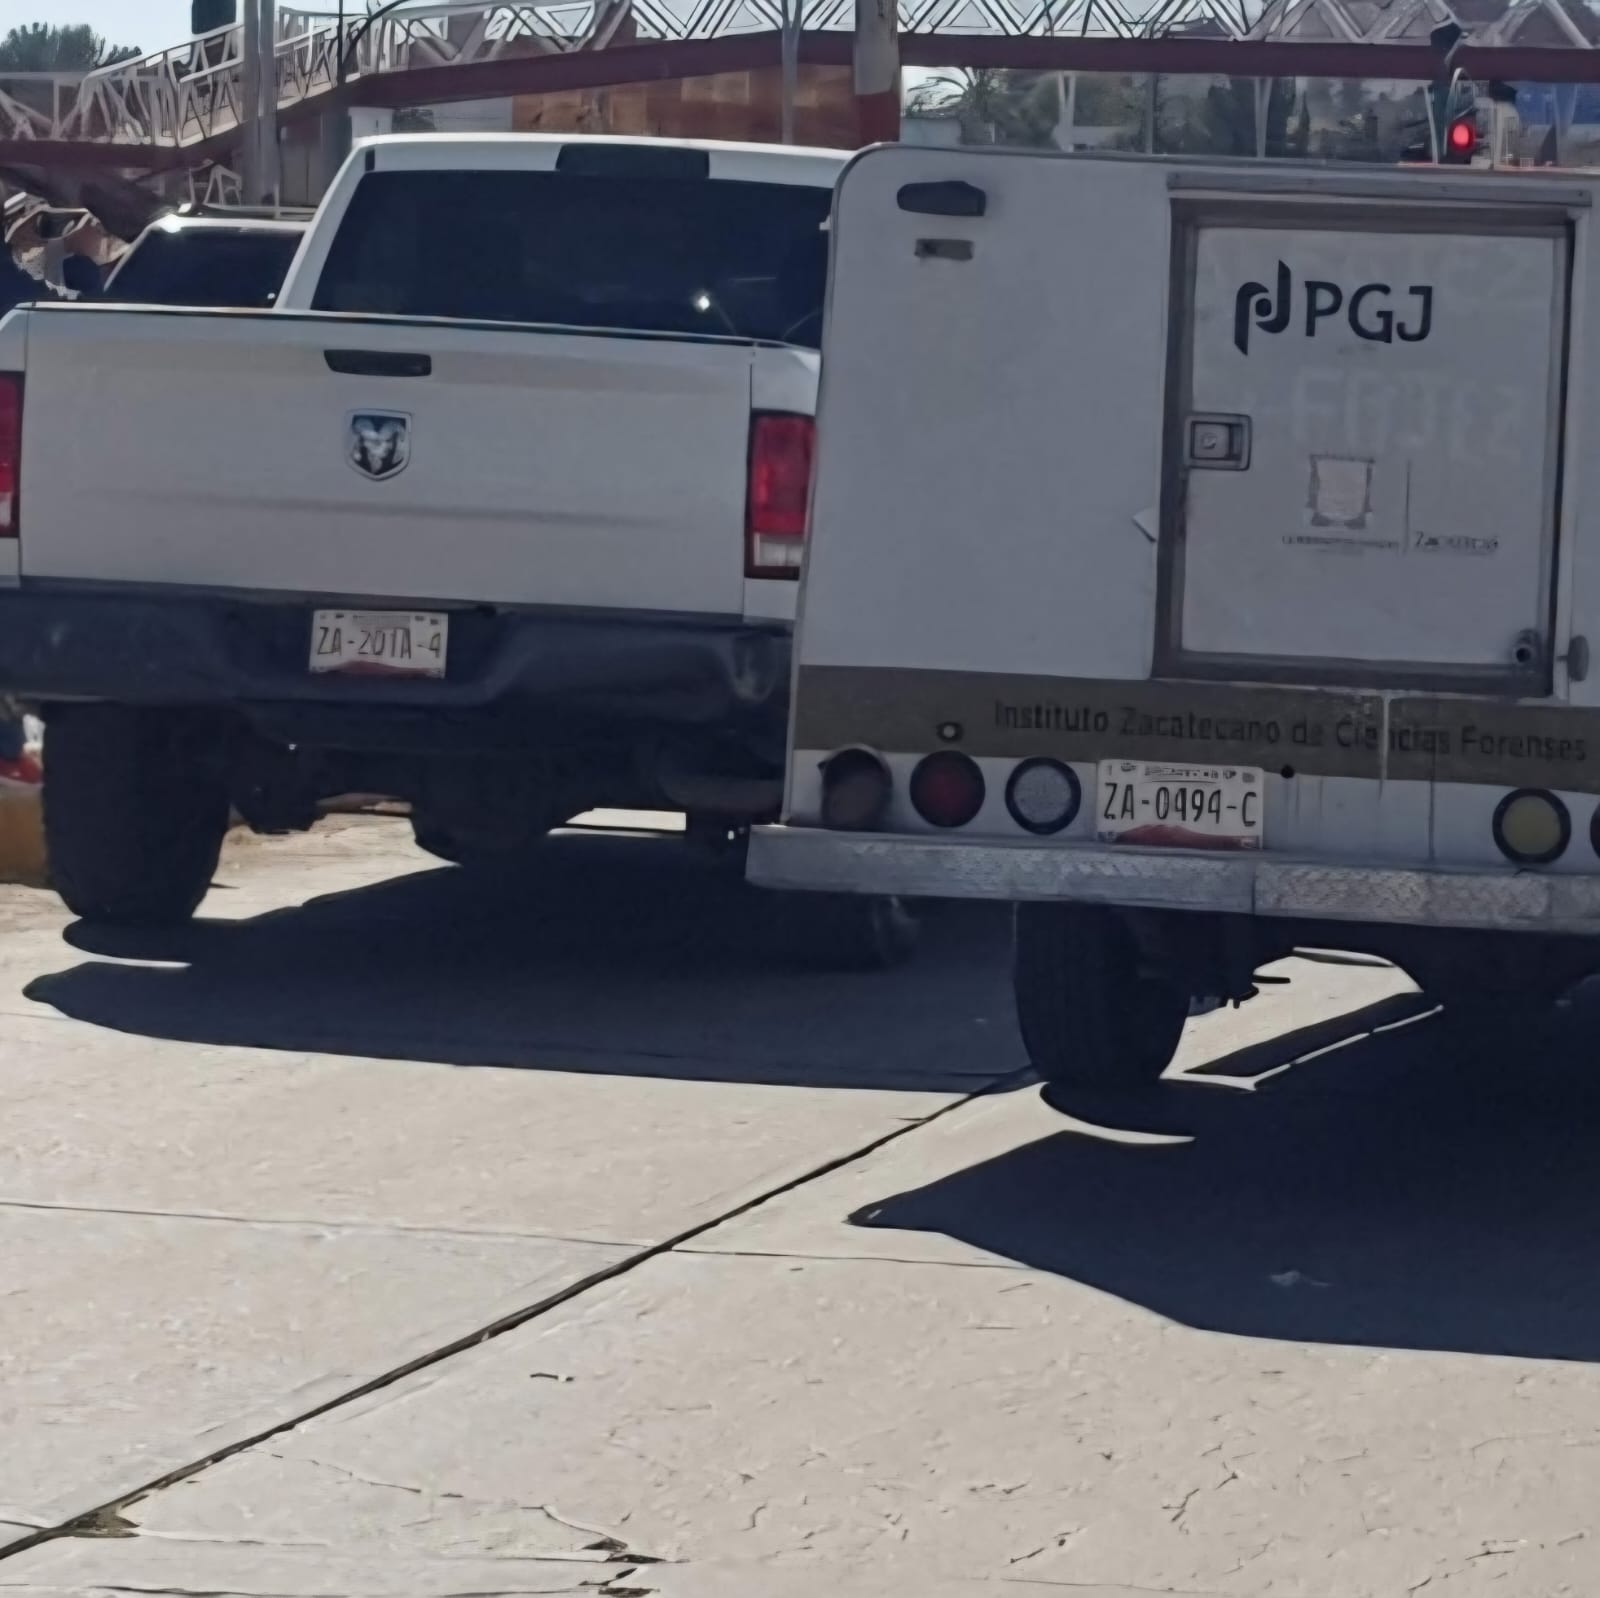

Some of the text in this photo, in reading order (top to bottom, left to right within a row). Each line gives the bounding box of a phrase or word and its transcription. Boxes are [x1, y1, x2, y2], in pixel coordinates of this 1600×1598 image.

[1303, 280, 1433, 343] PGJ
[994, 702, 1587, 761] Instituto Zacatecano de Ciencias Forenses
[1103, 782, 1257, 827] ZA-0494-C
